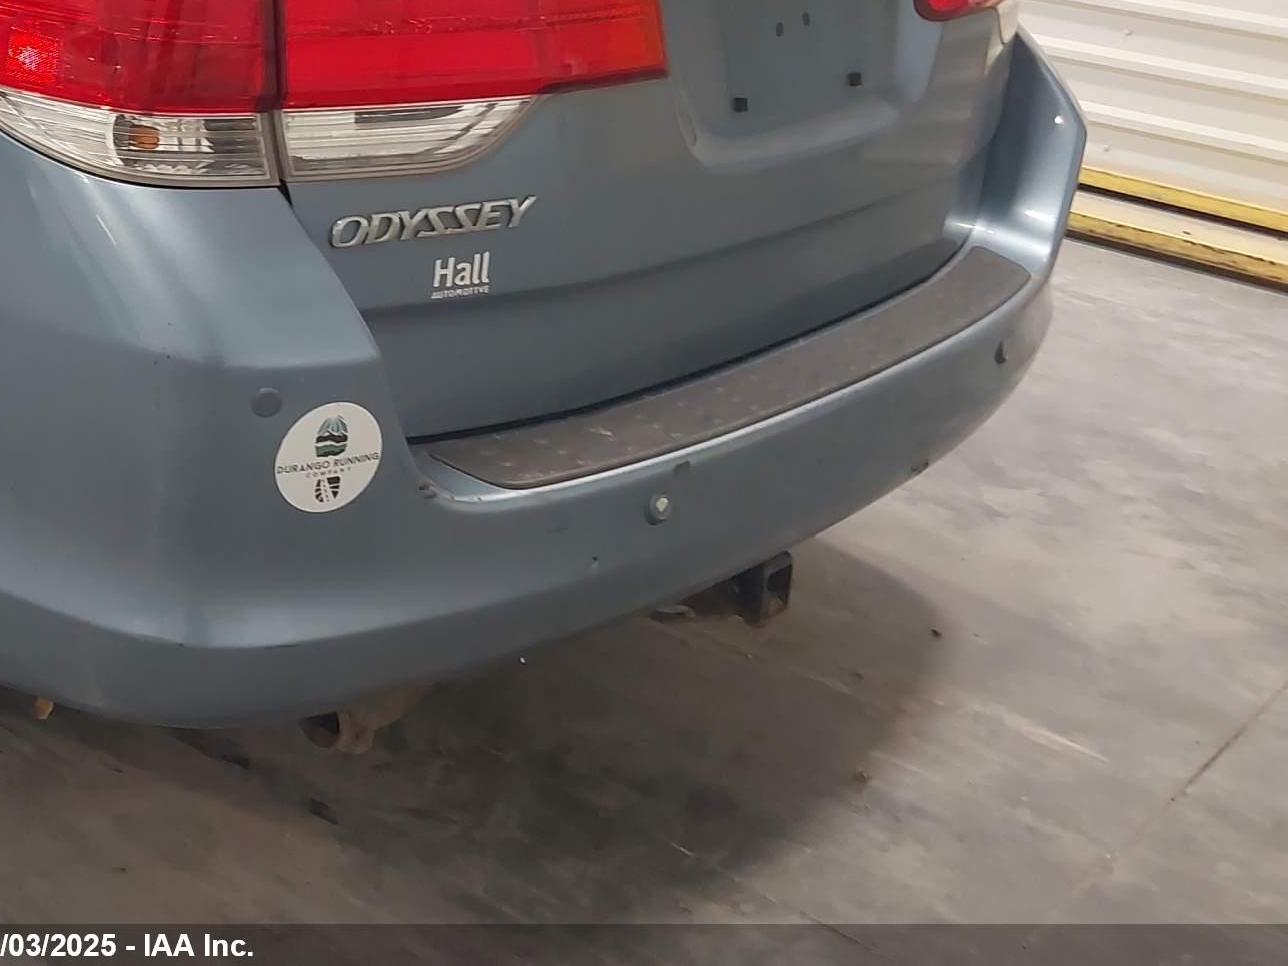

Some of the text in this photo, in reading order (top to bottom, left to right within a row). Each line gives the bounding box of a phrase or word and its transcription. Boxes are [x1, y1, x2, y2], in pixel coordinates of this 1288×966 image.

[330, 195, 537, 249] ODYSSEY
[433, 251, 490, 287] Hall
[431, 285, 489, 299] AUTOMOTIVE
[277, 452, 380, 475] DURANGO RUNNING
